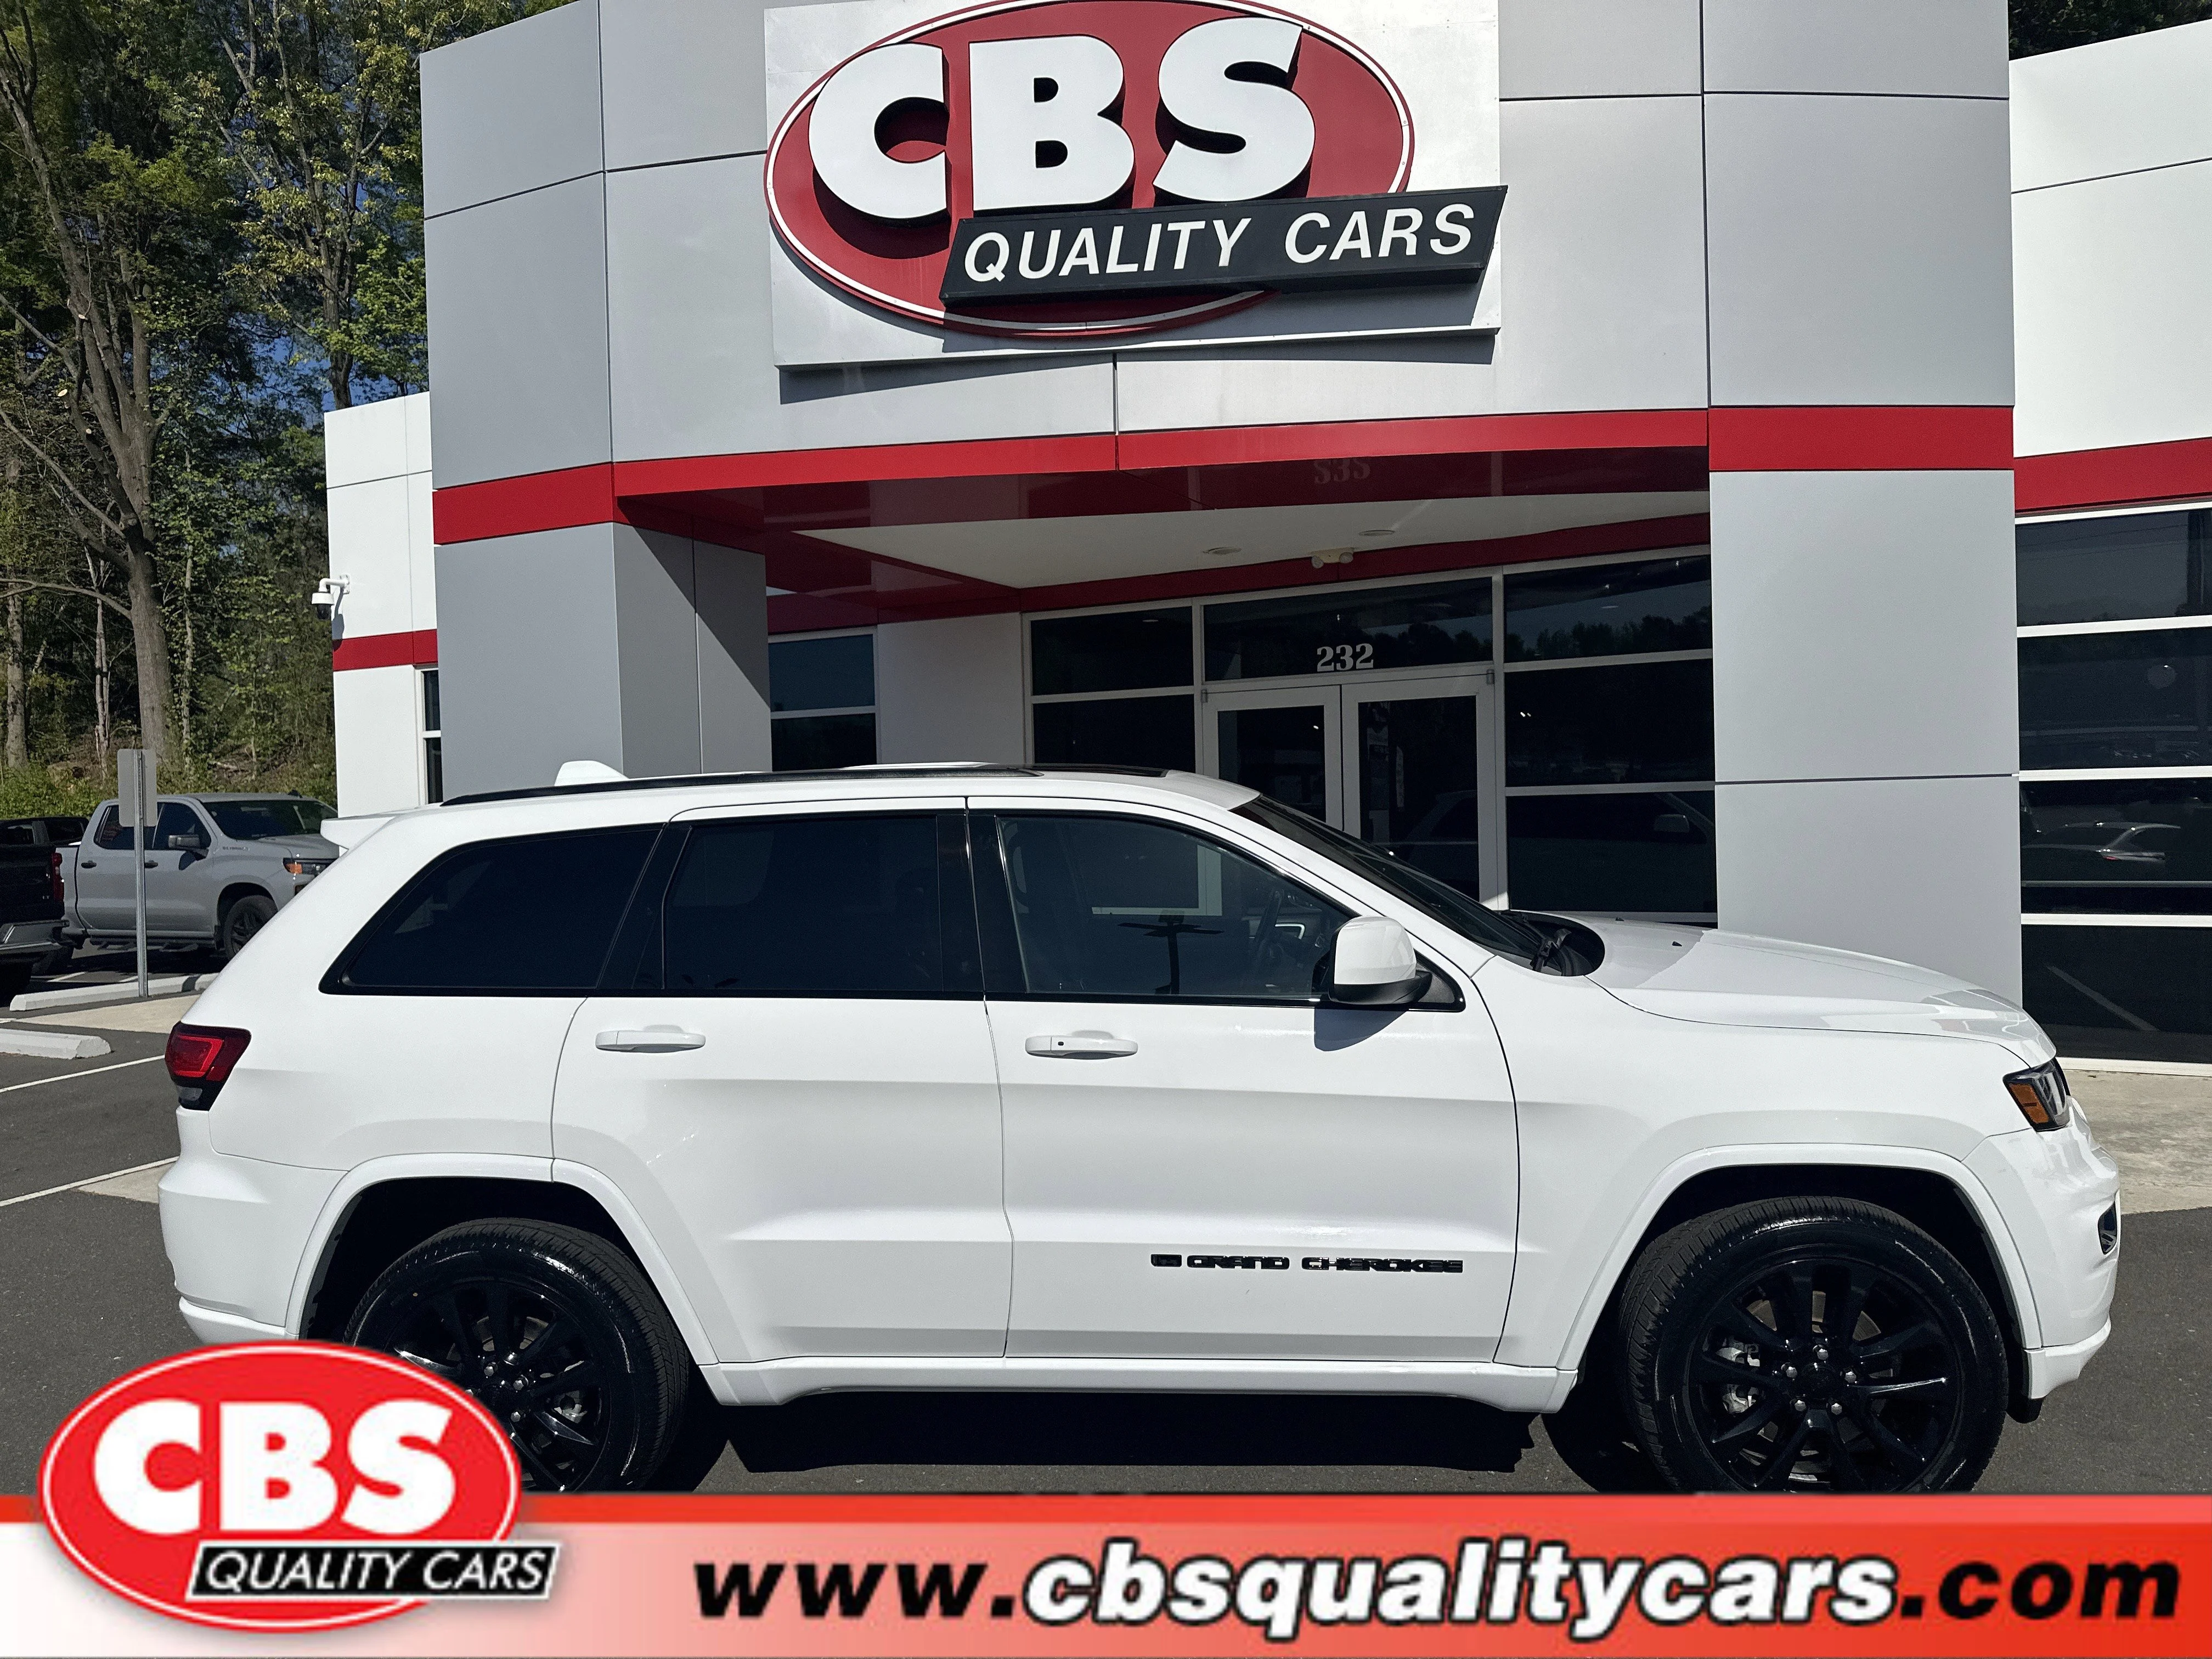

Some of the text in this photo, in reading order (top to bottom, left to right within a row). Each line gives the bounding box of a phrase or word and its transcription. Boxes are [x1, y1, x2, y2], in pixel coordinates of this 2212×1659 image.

[808, 16, 1316, 219] CBS
[964, 204, 1475, 283] QUALITY CARS
[1317, 643, 1374, 672] 232
[1187, 1255, 1290, 1270] GRAND
[1301, 1256, 1464, 1273] CHEROKEE
